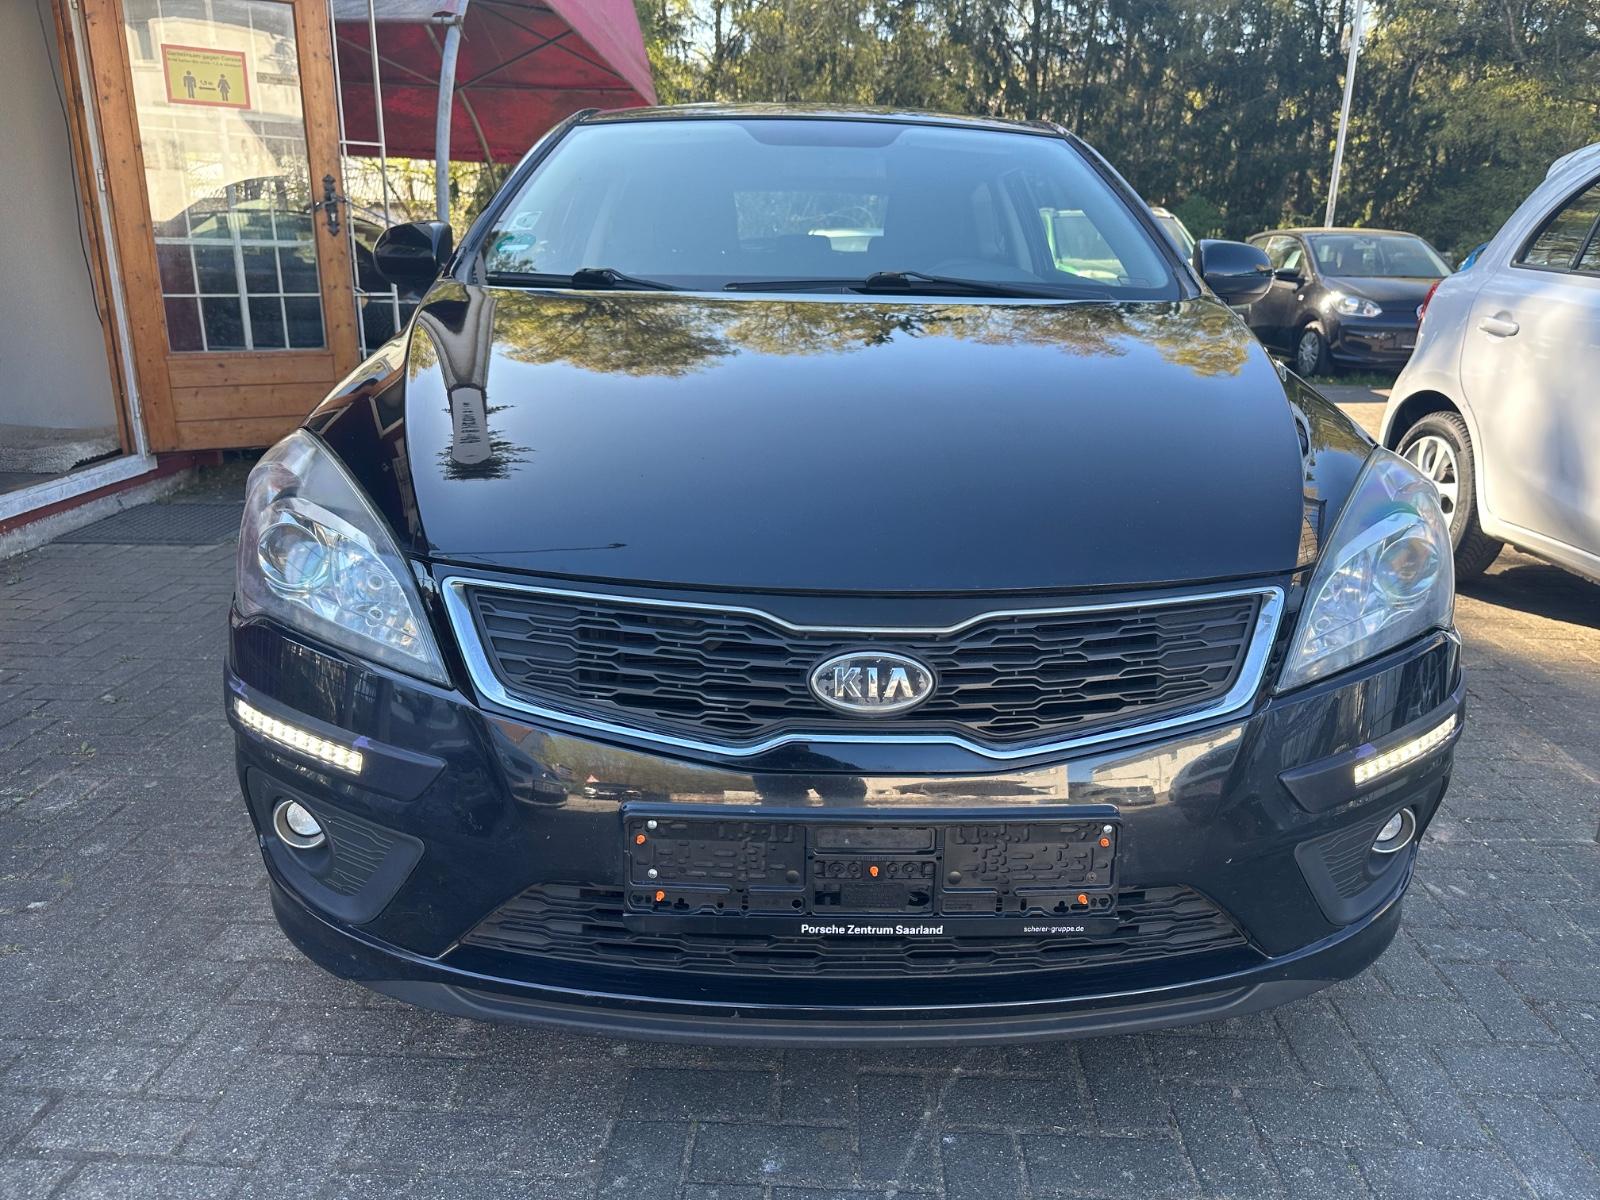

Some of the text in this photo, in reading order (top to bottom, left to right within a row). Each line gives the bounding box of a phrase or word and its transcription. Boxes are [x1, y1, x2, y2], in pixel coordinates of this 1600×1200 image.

[833, 666, 914, 698] KIA
[801, 924, 944, 935] Porsche Zentrum Saarland
[1023, 925, 1085, 934] scherer-gruppe.de
